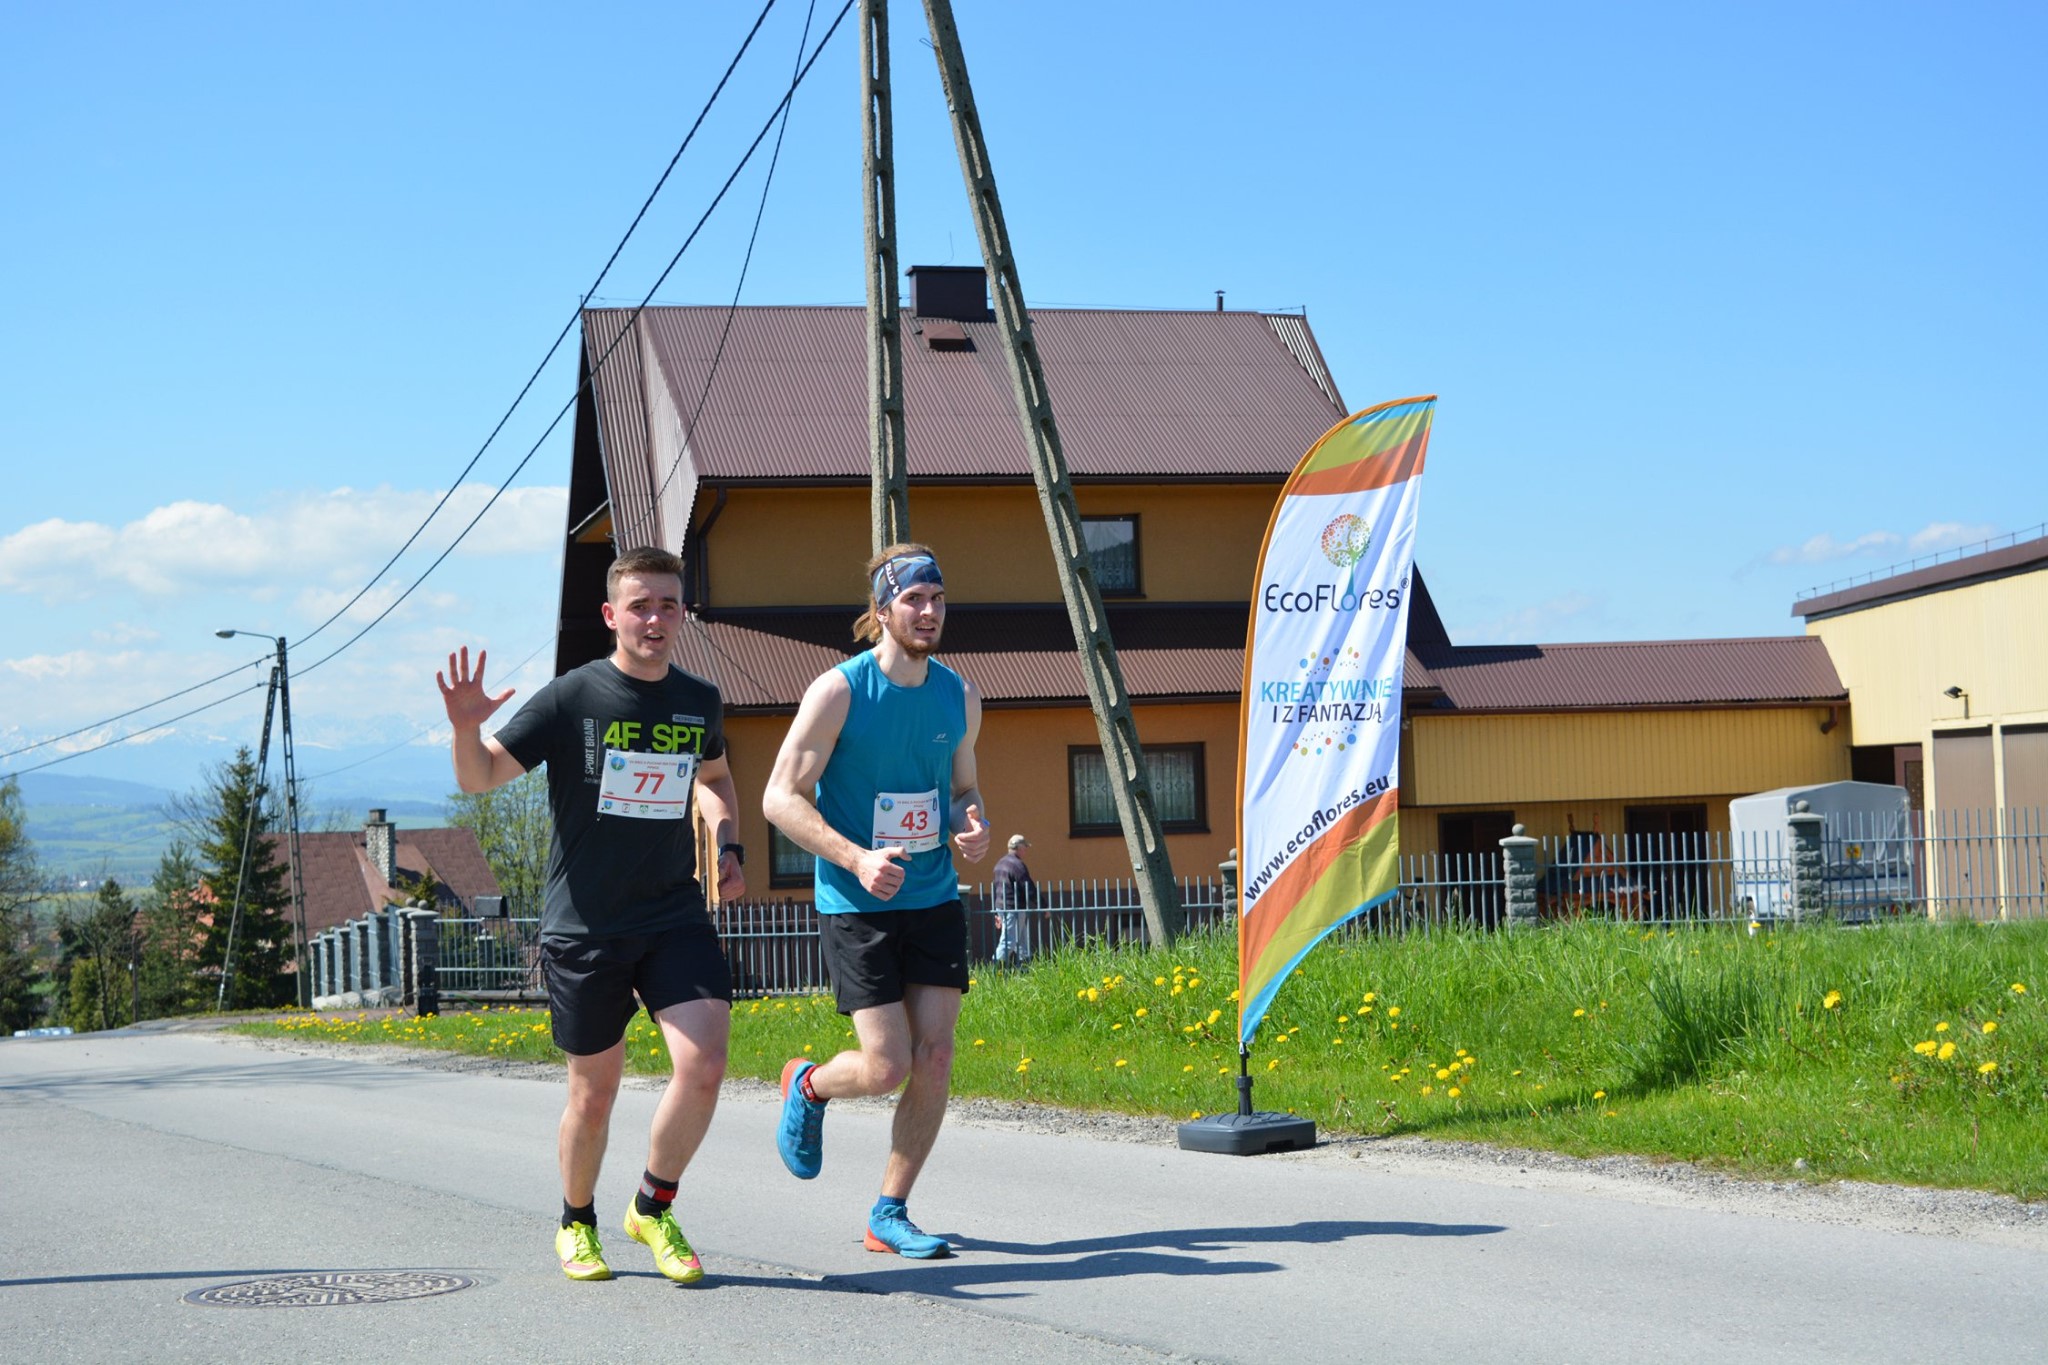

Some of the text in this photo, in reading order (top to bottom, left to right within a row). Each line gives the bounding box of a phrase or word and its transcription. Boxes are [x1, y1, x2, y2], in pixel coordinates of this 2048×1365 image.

[1261, 677, 1392, 703] KREATYWNIE
[1272, 702, 1382, 723] I Z FANTAZJĄ
[583, 718, 594, 747] BRAND
[603, 721, 705, 754] 4F SPT
[585, 750, 595, 775] SPORT
[633, 772, 665, 795] 77
[901, 810, 928, 831] 43
[1244, 775, 1390, 901] www.ecoflores.eu
